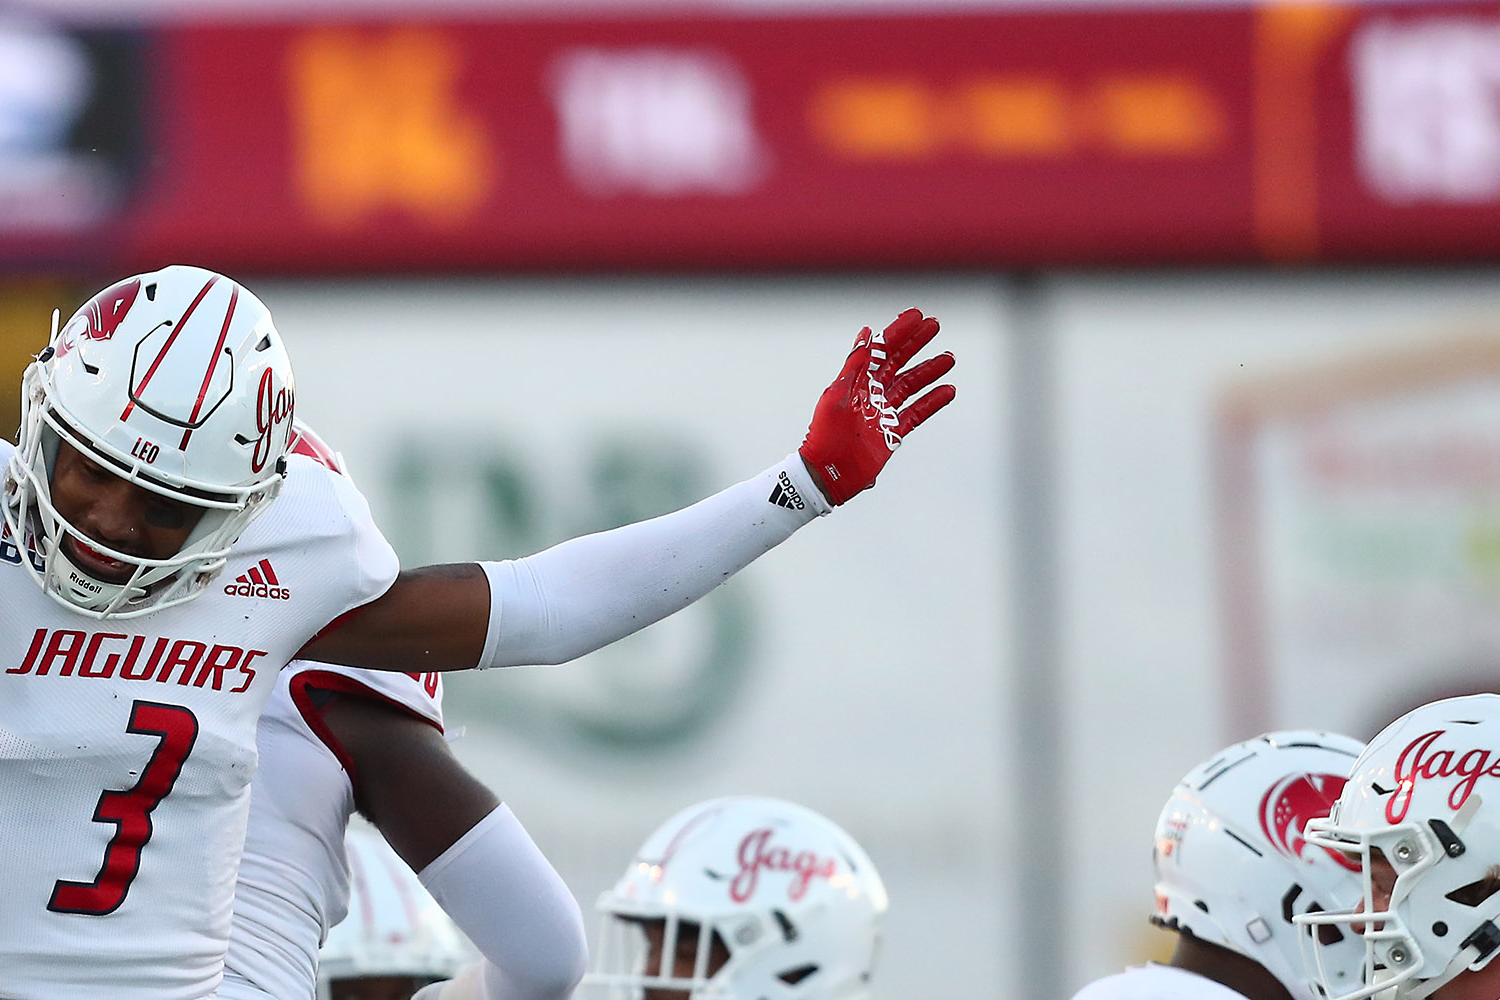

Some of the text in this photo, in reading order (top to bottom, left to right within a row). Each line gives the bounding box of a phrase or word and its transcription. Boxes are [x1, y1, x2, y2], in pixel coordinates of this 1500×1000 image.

[131, 437, 160, 464] LEO
[778, 471, 805, 511] adidas
[69, 571, 104, 594] Riddell
[224, 583, 290, 600] adidas
[5, 628, 269, 693] JAGUARS
[47, 698, 199, 916] 3
[729, 828, 835, 903] Jags
